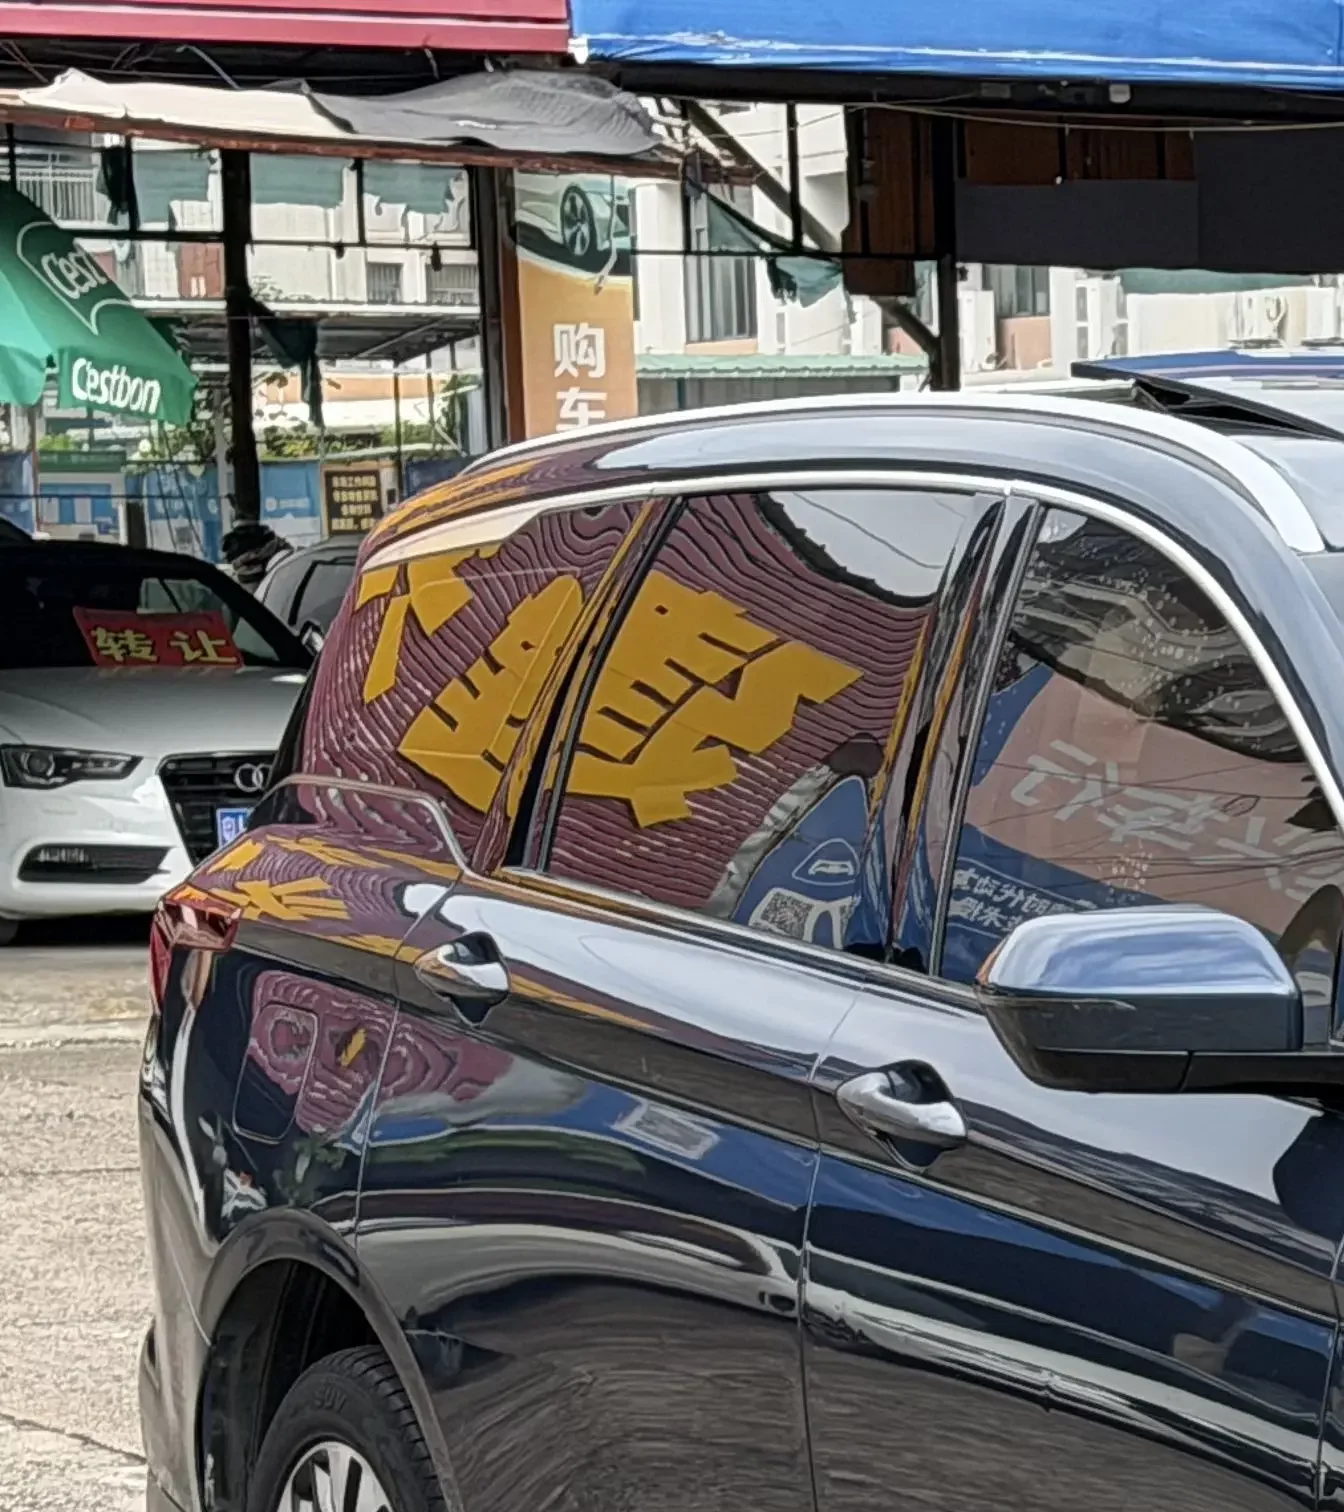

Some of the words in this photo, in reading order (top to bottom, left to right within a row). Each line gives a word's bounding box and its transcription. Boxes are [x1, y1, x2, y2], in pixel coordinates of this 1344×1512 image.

[72, 358, 161, 424] C'estbon
[553, 322, 607, 432] 购车
[90, 627, 237, 663] 转让
